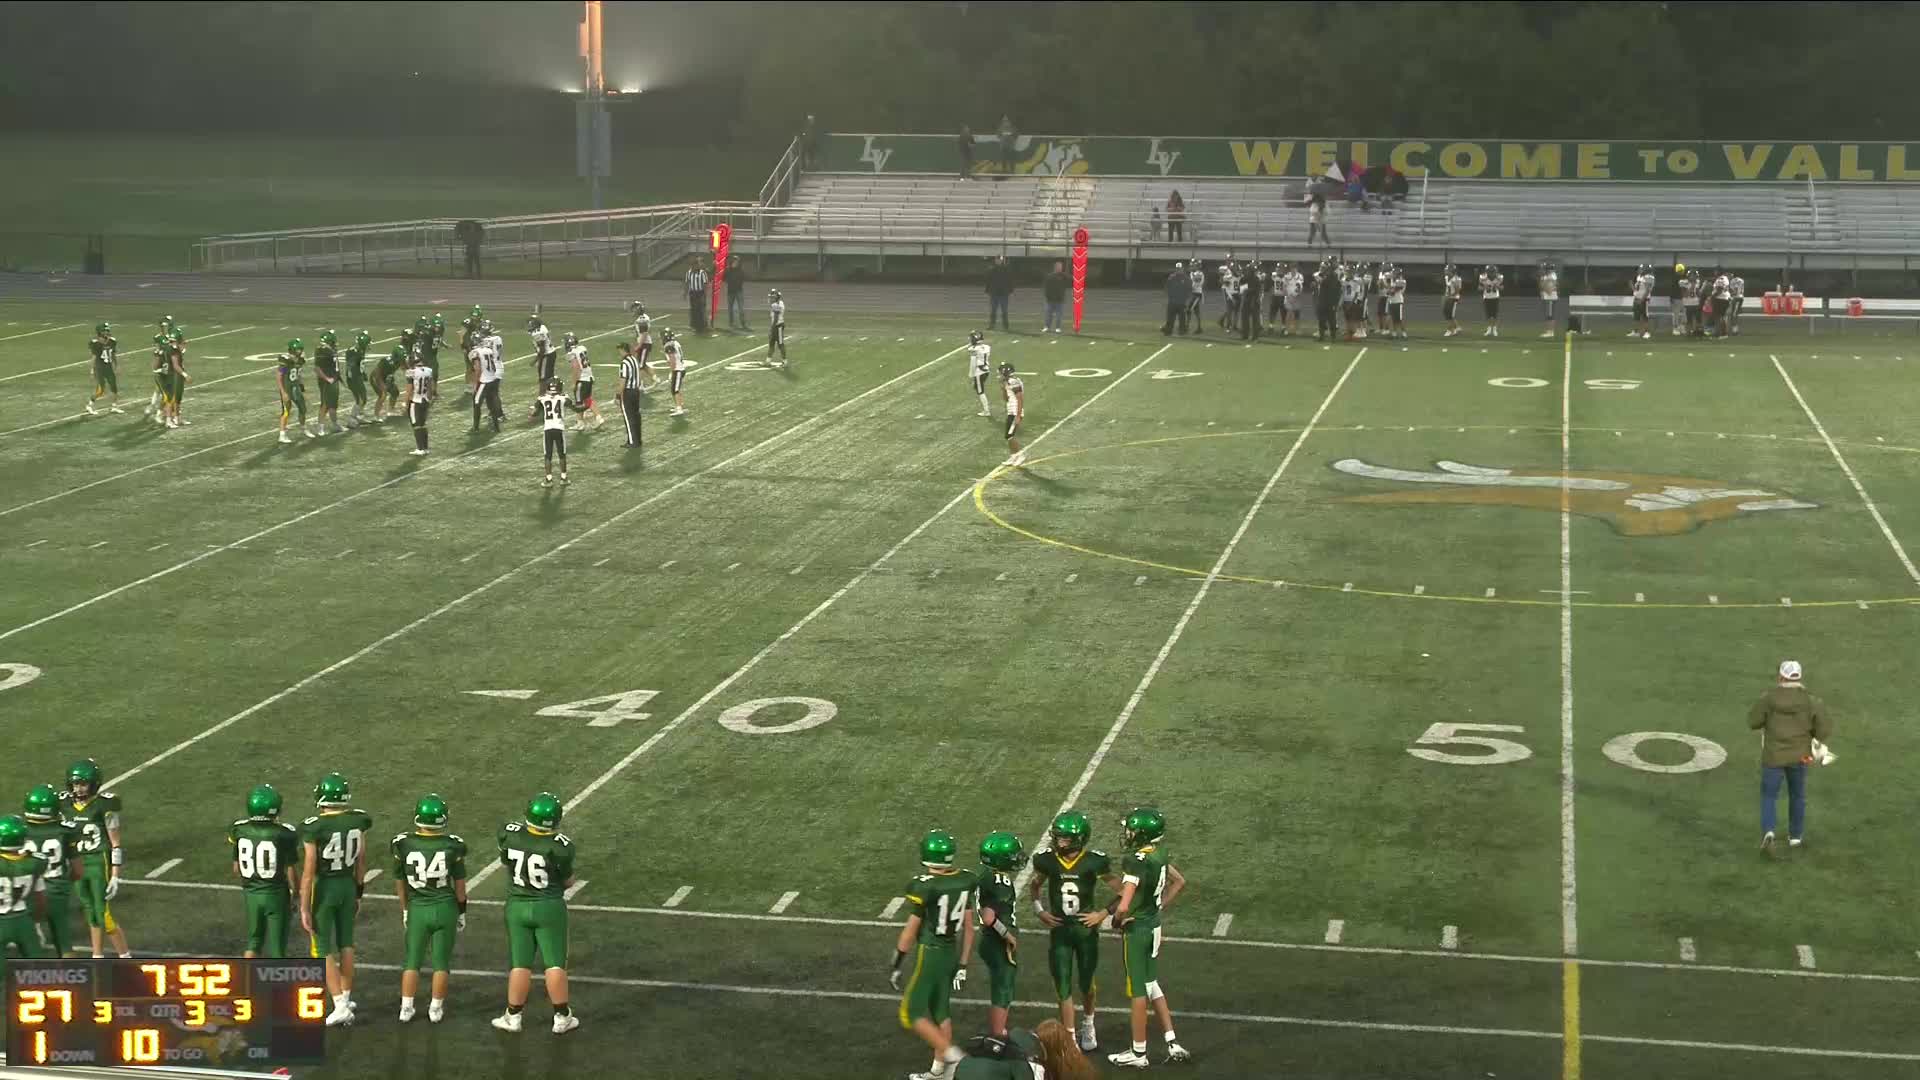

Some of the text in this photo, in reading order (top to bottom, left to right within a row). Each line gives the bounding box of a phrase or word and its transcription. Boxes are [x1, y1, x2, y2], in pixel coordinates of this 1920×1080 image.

[545, 399, 563, 420] 24
[238, 837, 277, 879] 80
[322, 829, 362, 871] 40
[406, 851, 449, 889] 34
[507, 848, 550, 889] 76
[935, 890, 969, 935] 14
[1061, 881, 1080, 916] 6
